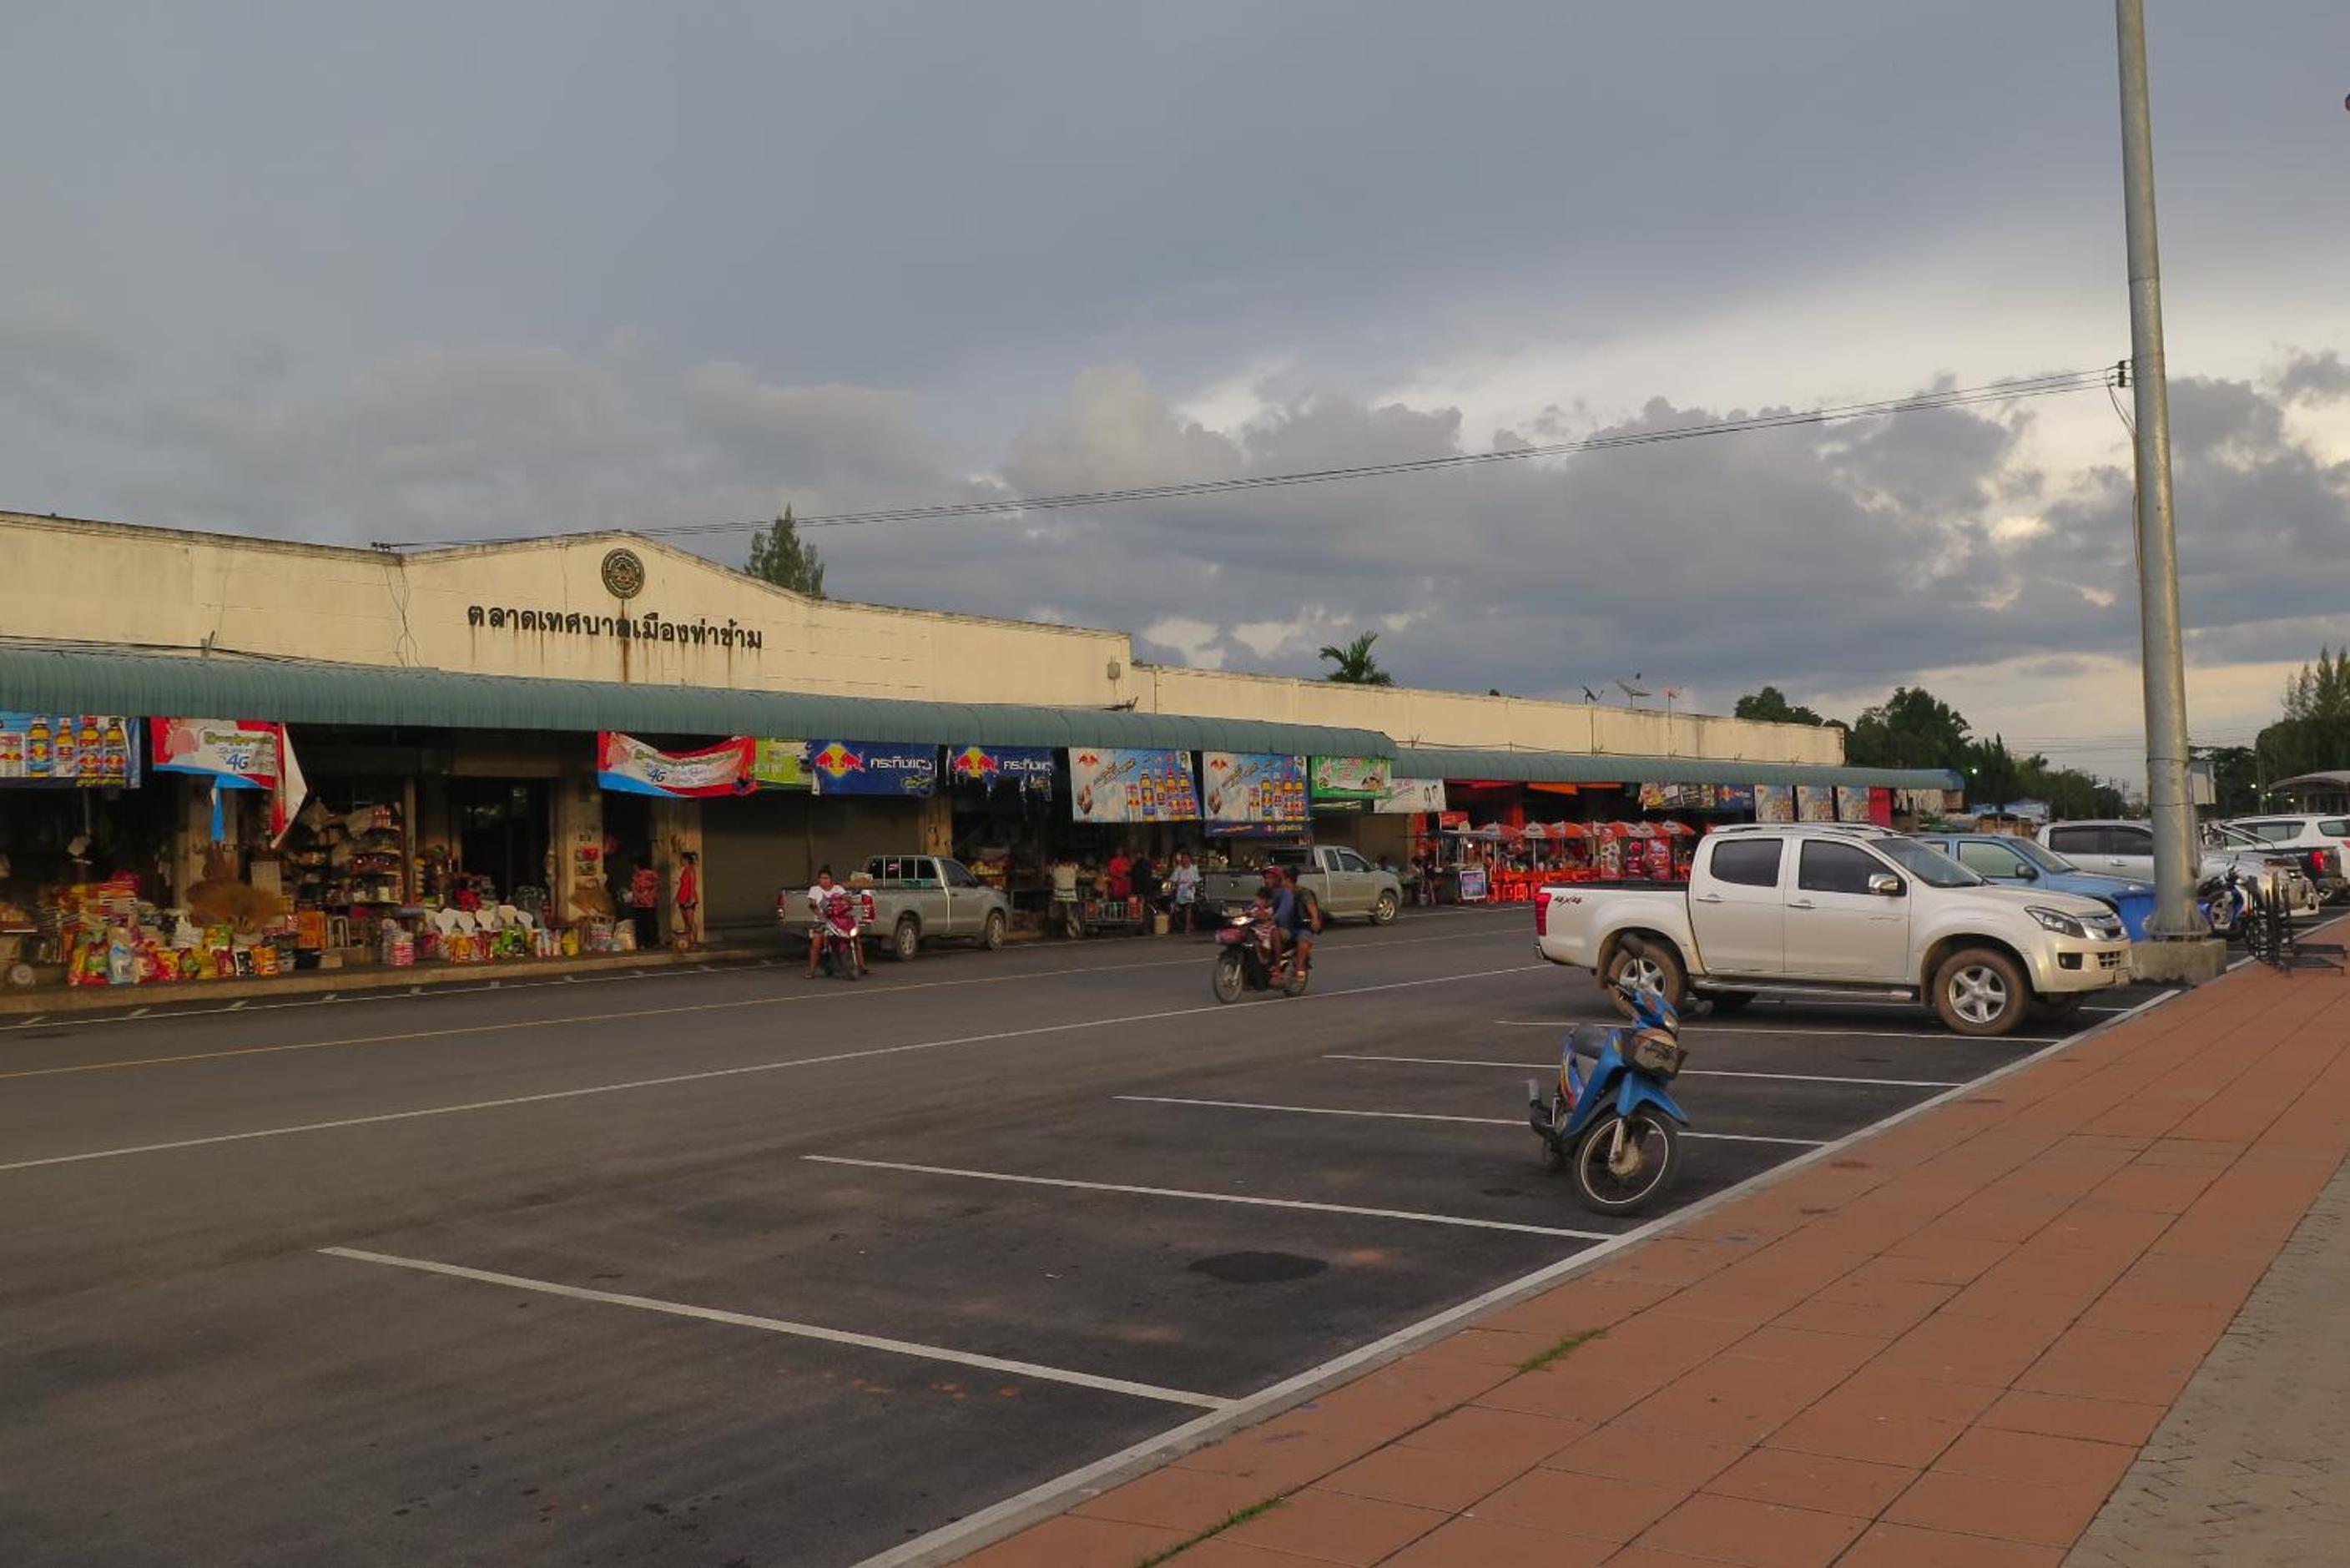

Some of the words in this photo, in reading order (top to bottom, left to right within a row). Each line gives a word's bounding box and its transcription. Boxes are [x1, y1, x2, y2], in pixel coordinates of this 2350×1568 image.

[468, 605, 763, 649] ตลาดเทศบาลเมืองท่าข้าม
[226, 754, 250, 770] 4G
